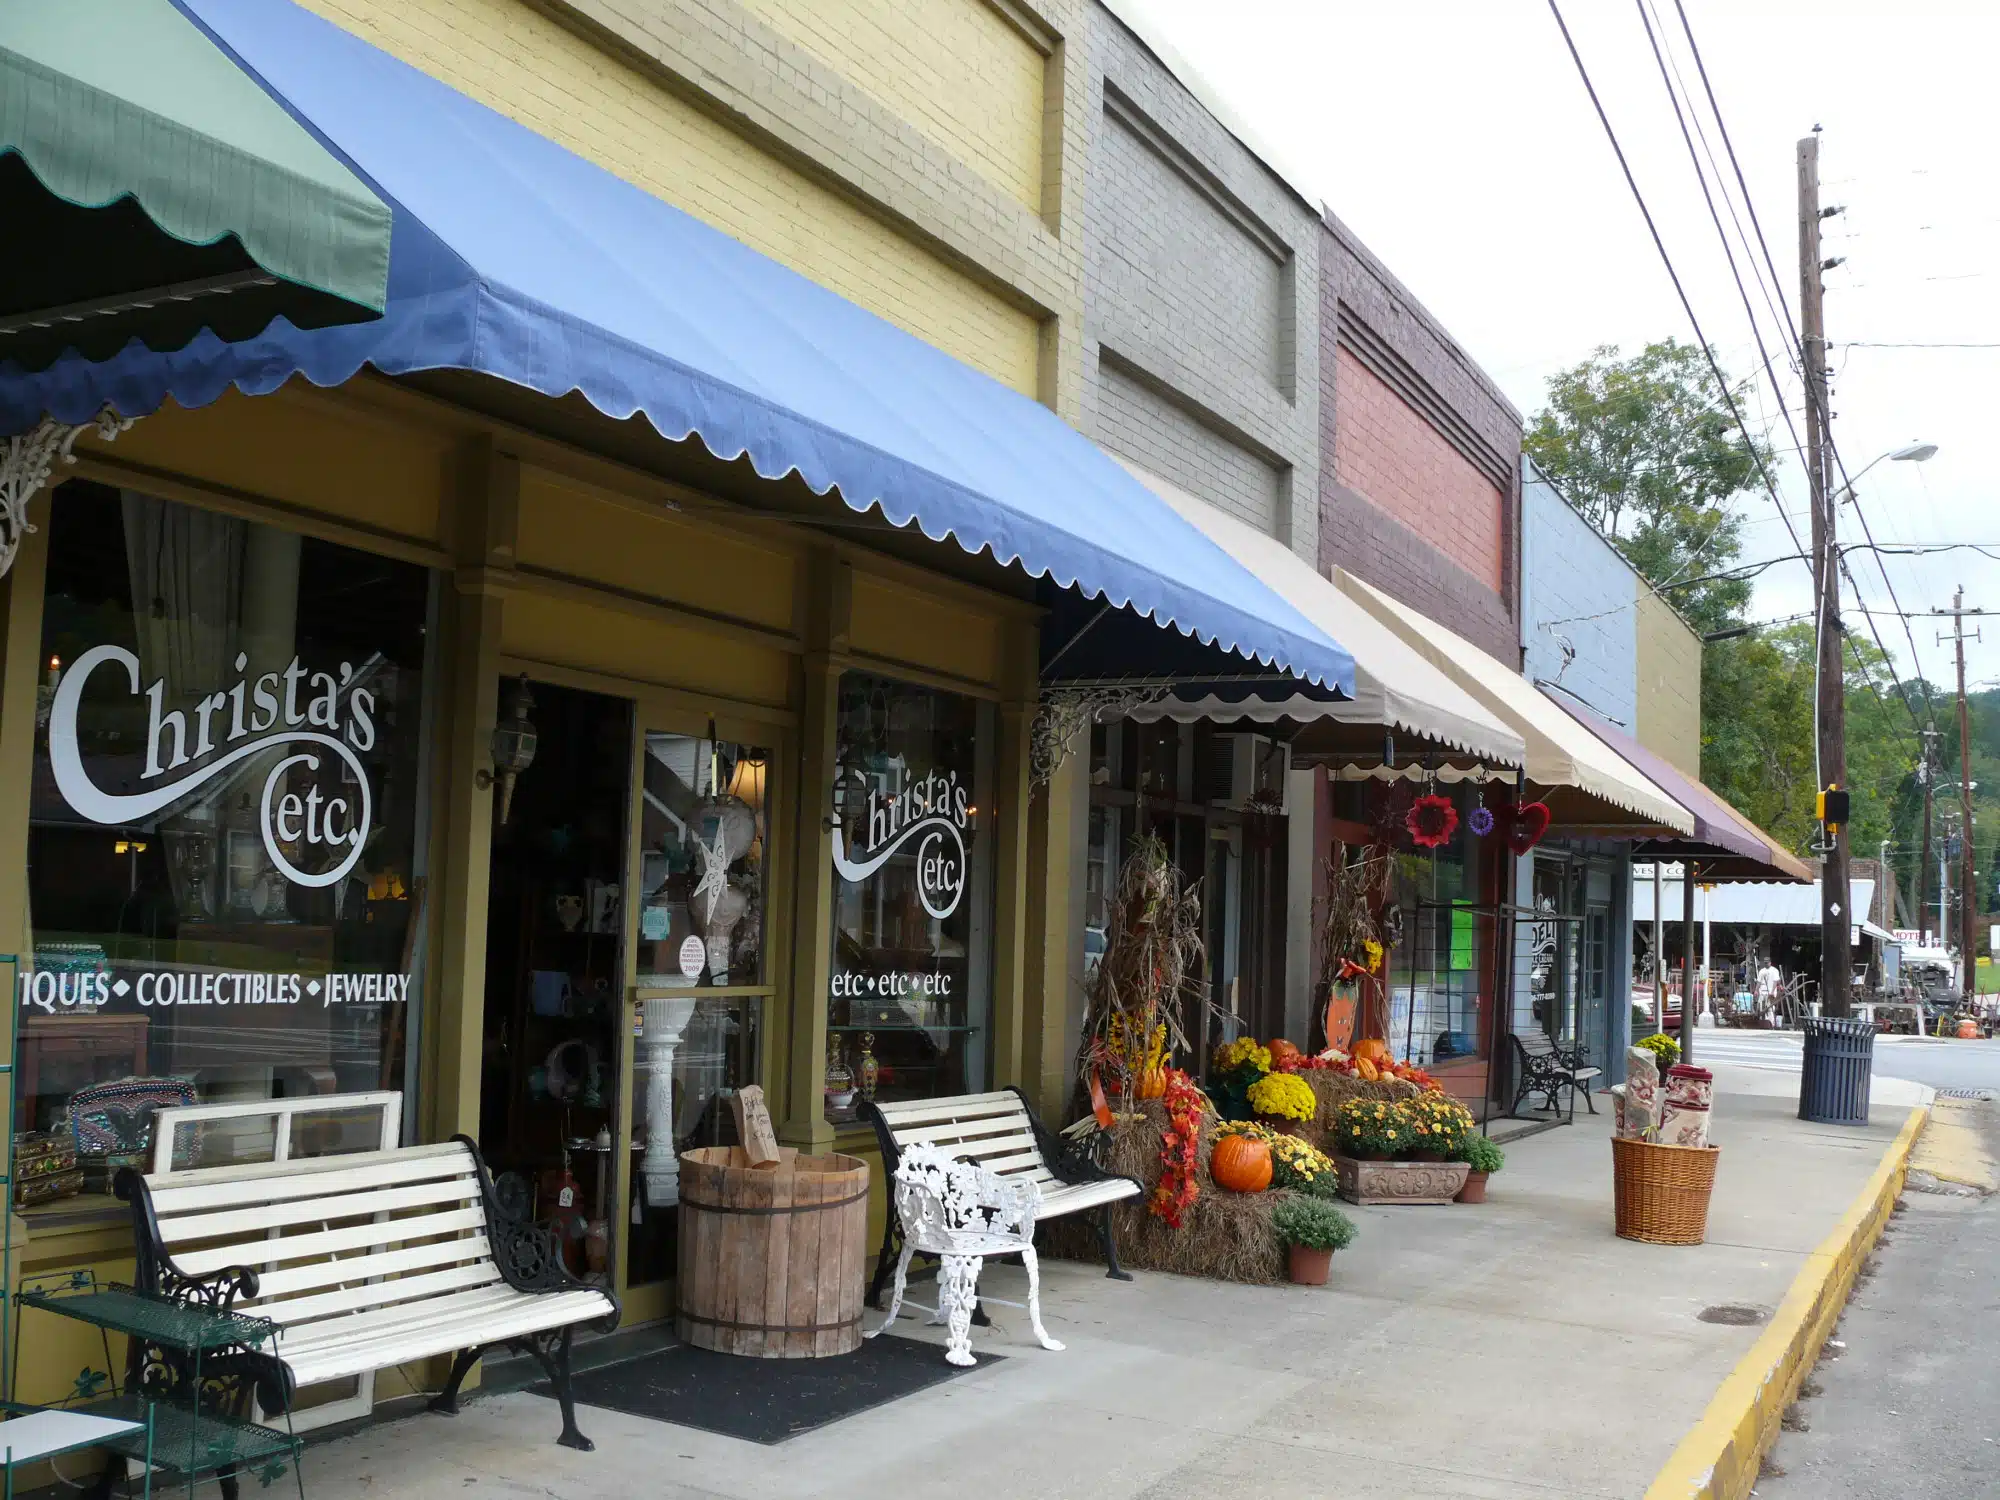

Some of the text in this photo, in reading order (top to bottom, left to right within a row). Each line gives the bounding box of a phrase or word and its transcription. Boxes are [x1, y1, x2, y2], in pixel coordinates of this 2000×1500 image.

[49, 645, 375, 824] Christa's
[277, 783, 361, 847] etc.
[1893, 931, 1929, 941] MOTE
[19, 971, 411, 1013] IQUES COLLECTIBLES JEWELRY
[831, 969, 951, 997] etc etc etc
